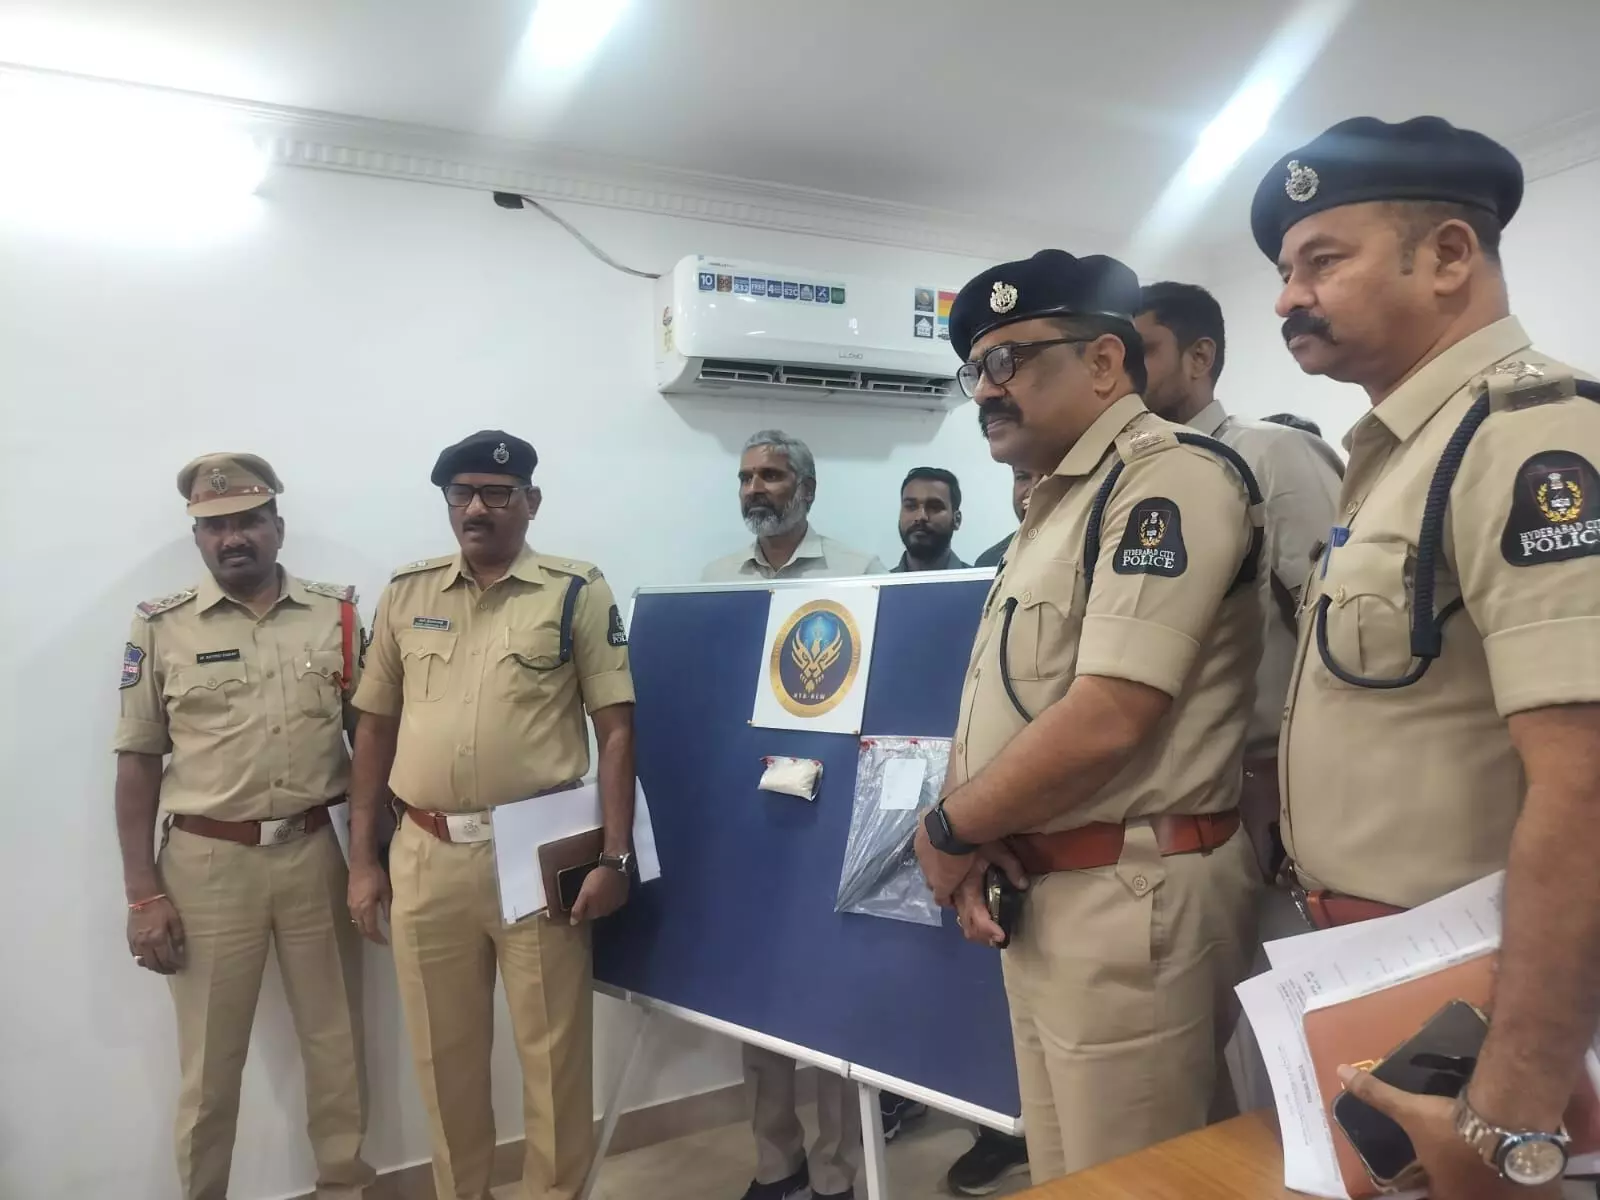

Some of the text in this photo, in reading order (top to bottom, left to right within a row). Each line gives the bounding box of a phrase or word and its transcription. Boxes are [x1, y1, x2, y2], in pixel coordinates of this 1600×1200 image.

[701, 275, 713, 286] 10
[1519, 519, 1600, 541] HYDERABAD CIT
[1520, 529, 1600, 556] POLIC
[1123, 549, 1175, 559] HYDERABAD CITY
[1122, 556, 1175, 569] POLICE
